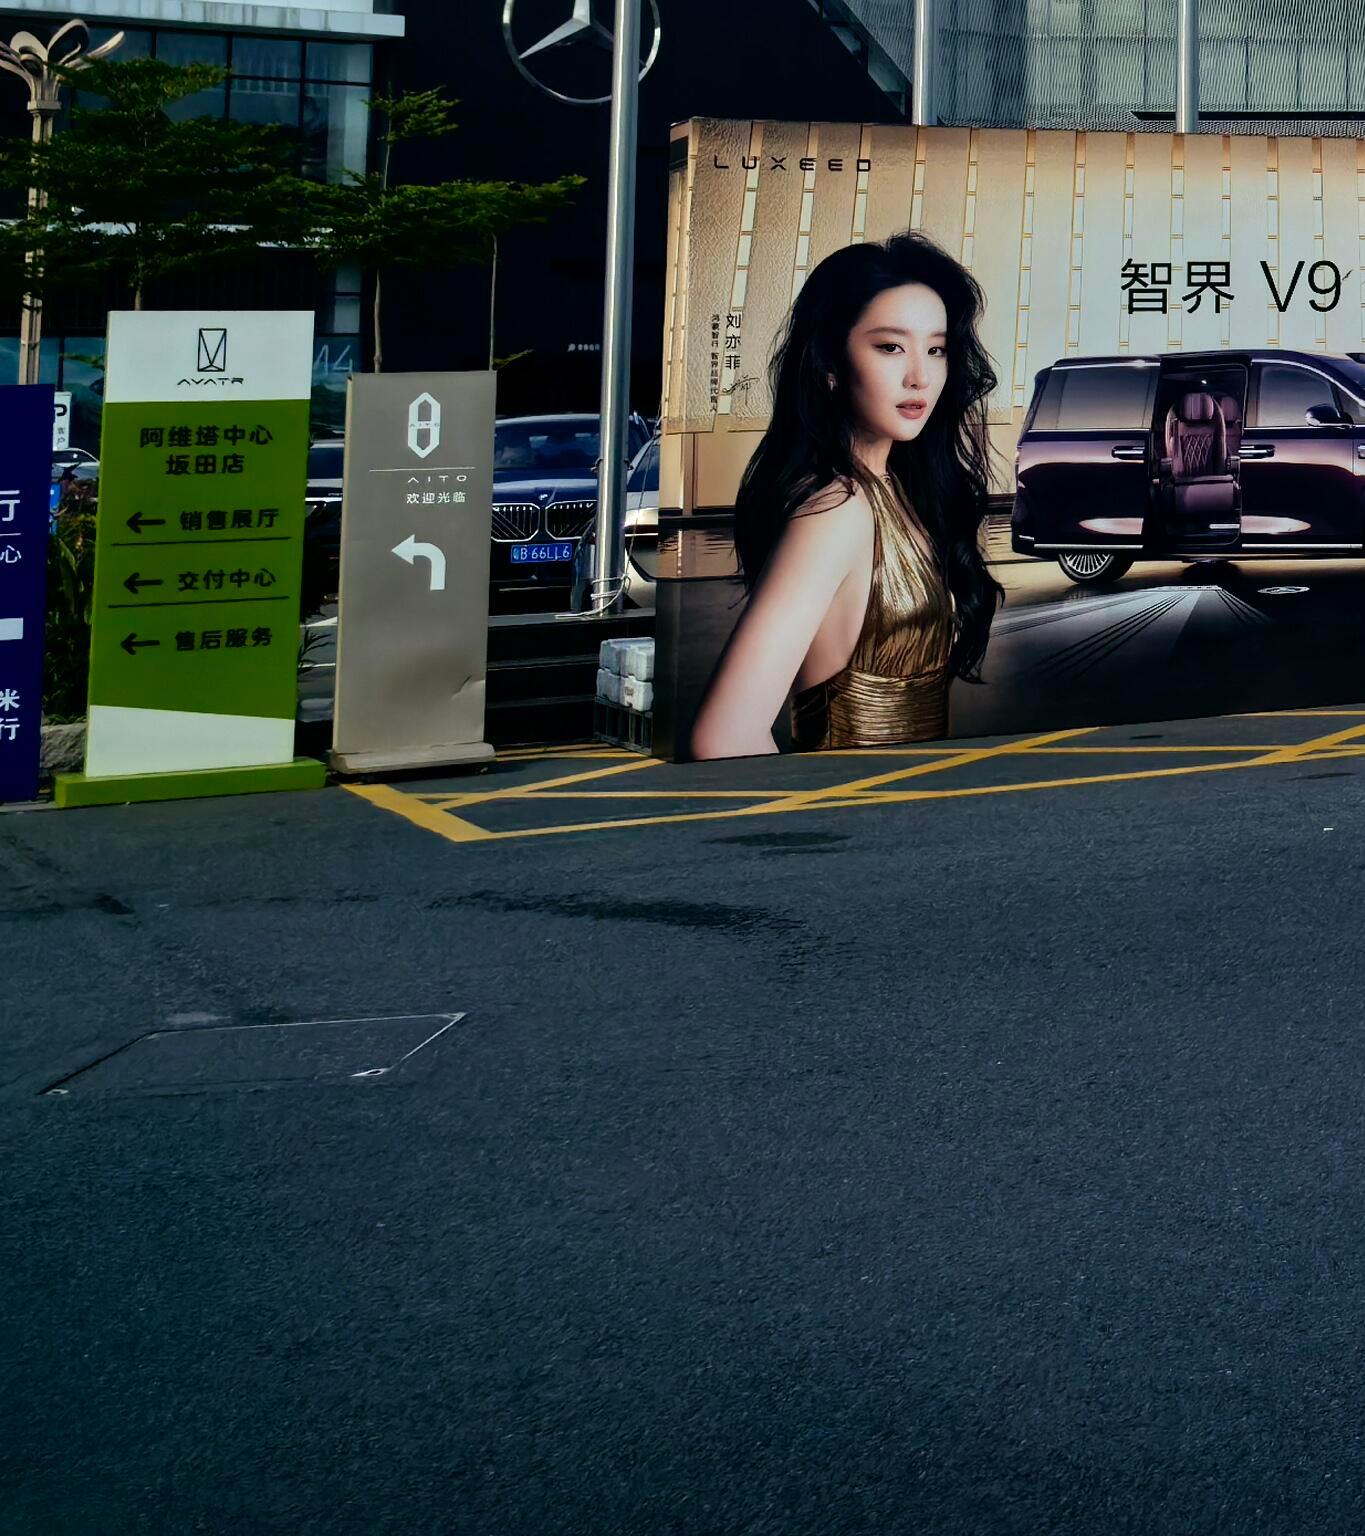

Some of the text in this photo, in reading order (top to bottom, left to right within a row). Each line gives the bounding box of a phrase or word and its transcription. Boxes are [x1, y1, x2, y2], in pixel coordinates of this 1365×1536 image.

[714, 154, 872, 172] LUXEED
[1120, 258, 1342, 314] 智界 V9
[725, 313, 742, 369] 刘亦菲
[177, 377, 245, 386] AVATR
[140, 425, 273, 448] 阿维塔中心
[165, 454, 245, 475] 坂田店
[407, 474, 467, 484] AITO
[406, 491, 467, 505] 欢迎光临
[179, 508, 279, 531] 销售展厅
[178, 567, 276, 592] 交付中心
[175, 626, 272, 651] 售后服务
